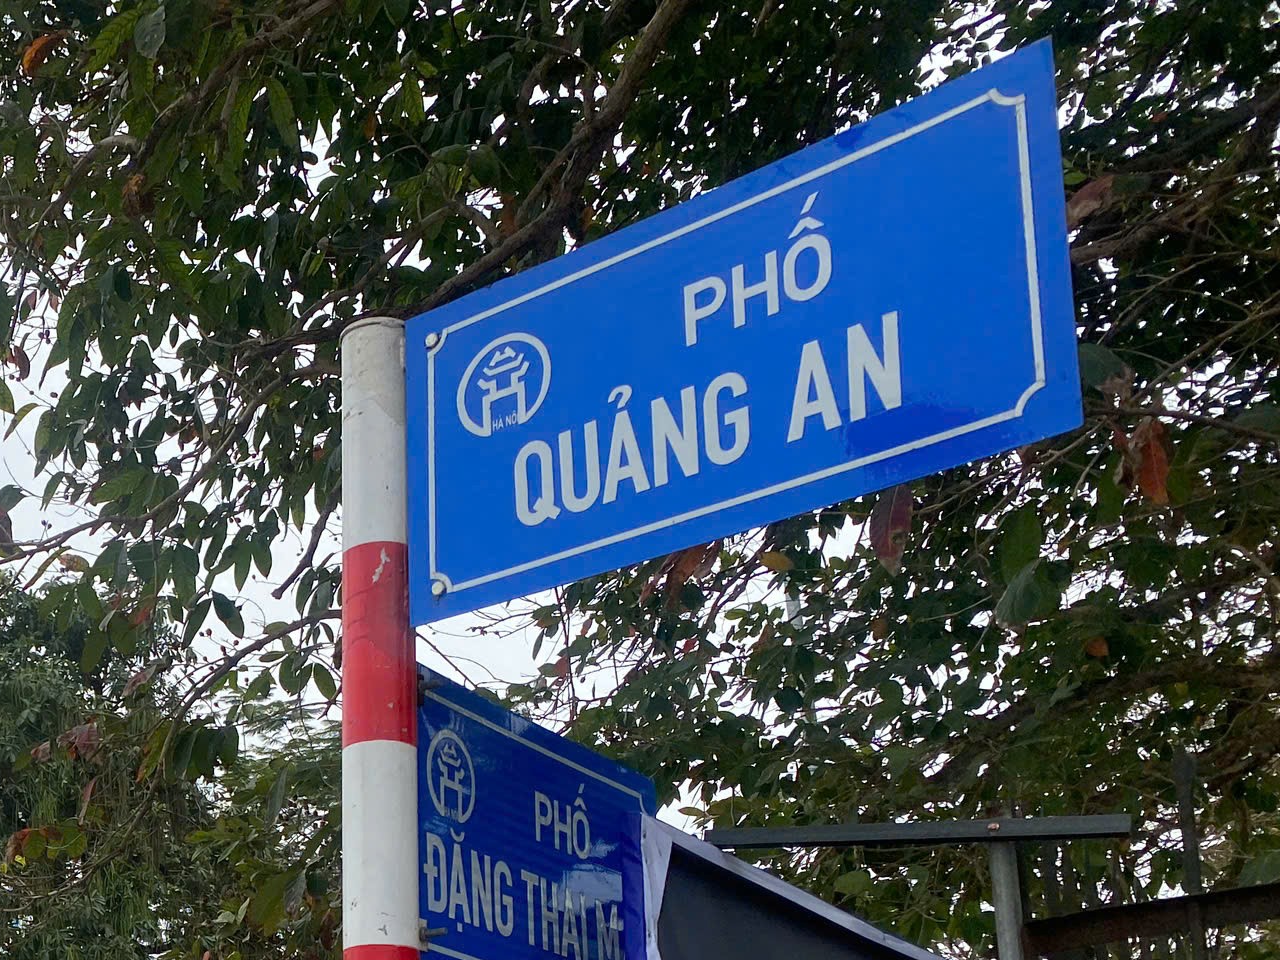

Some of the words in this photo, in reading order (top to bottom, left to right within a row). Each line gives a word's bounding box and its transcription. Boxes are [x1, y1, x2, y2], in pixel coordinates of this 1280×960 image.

[682, 191, 833, 347] PHỐ
[513, 385, 751, 527] QUẢNG
[786, 310, 903, 443] AN
[423, 830, 514, 938] ĐẶNG
[534, 783, 591, 860] PHỐ
